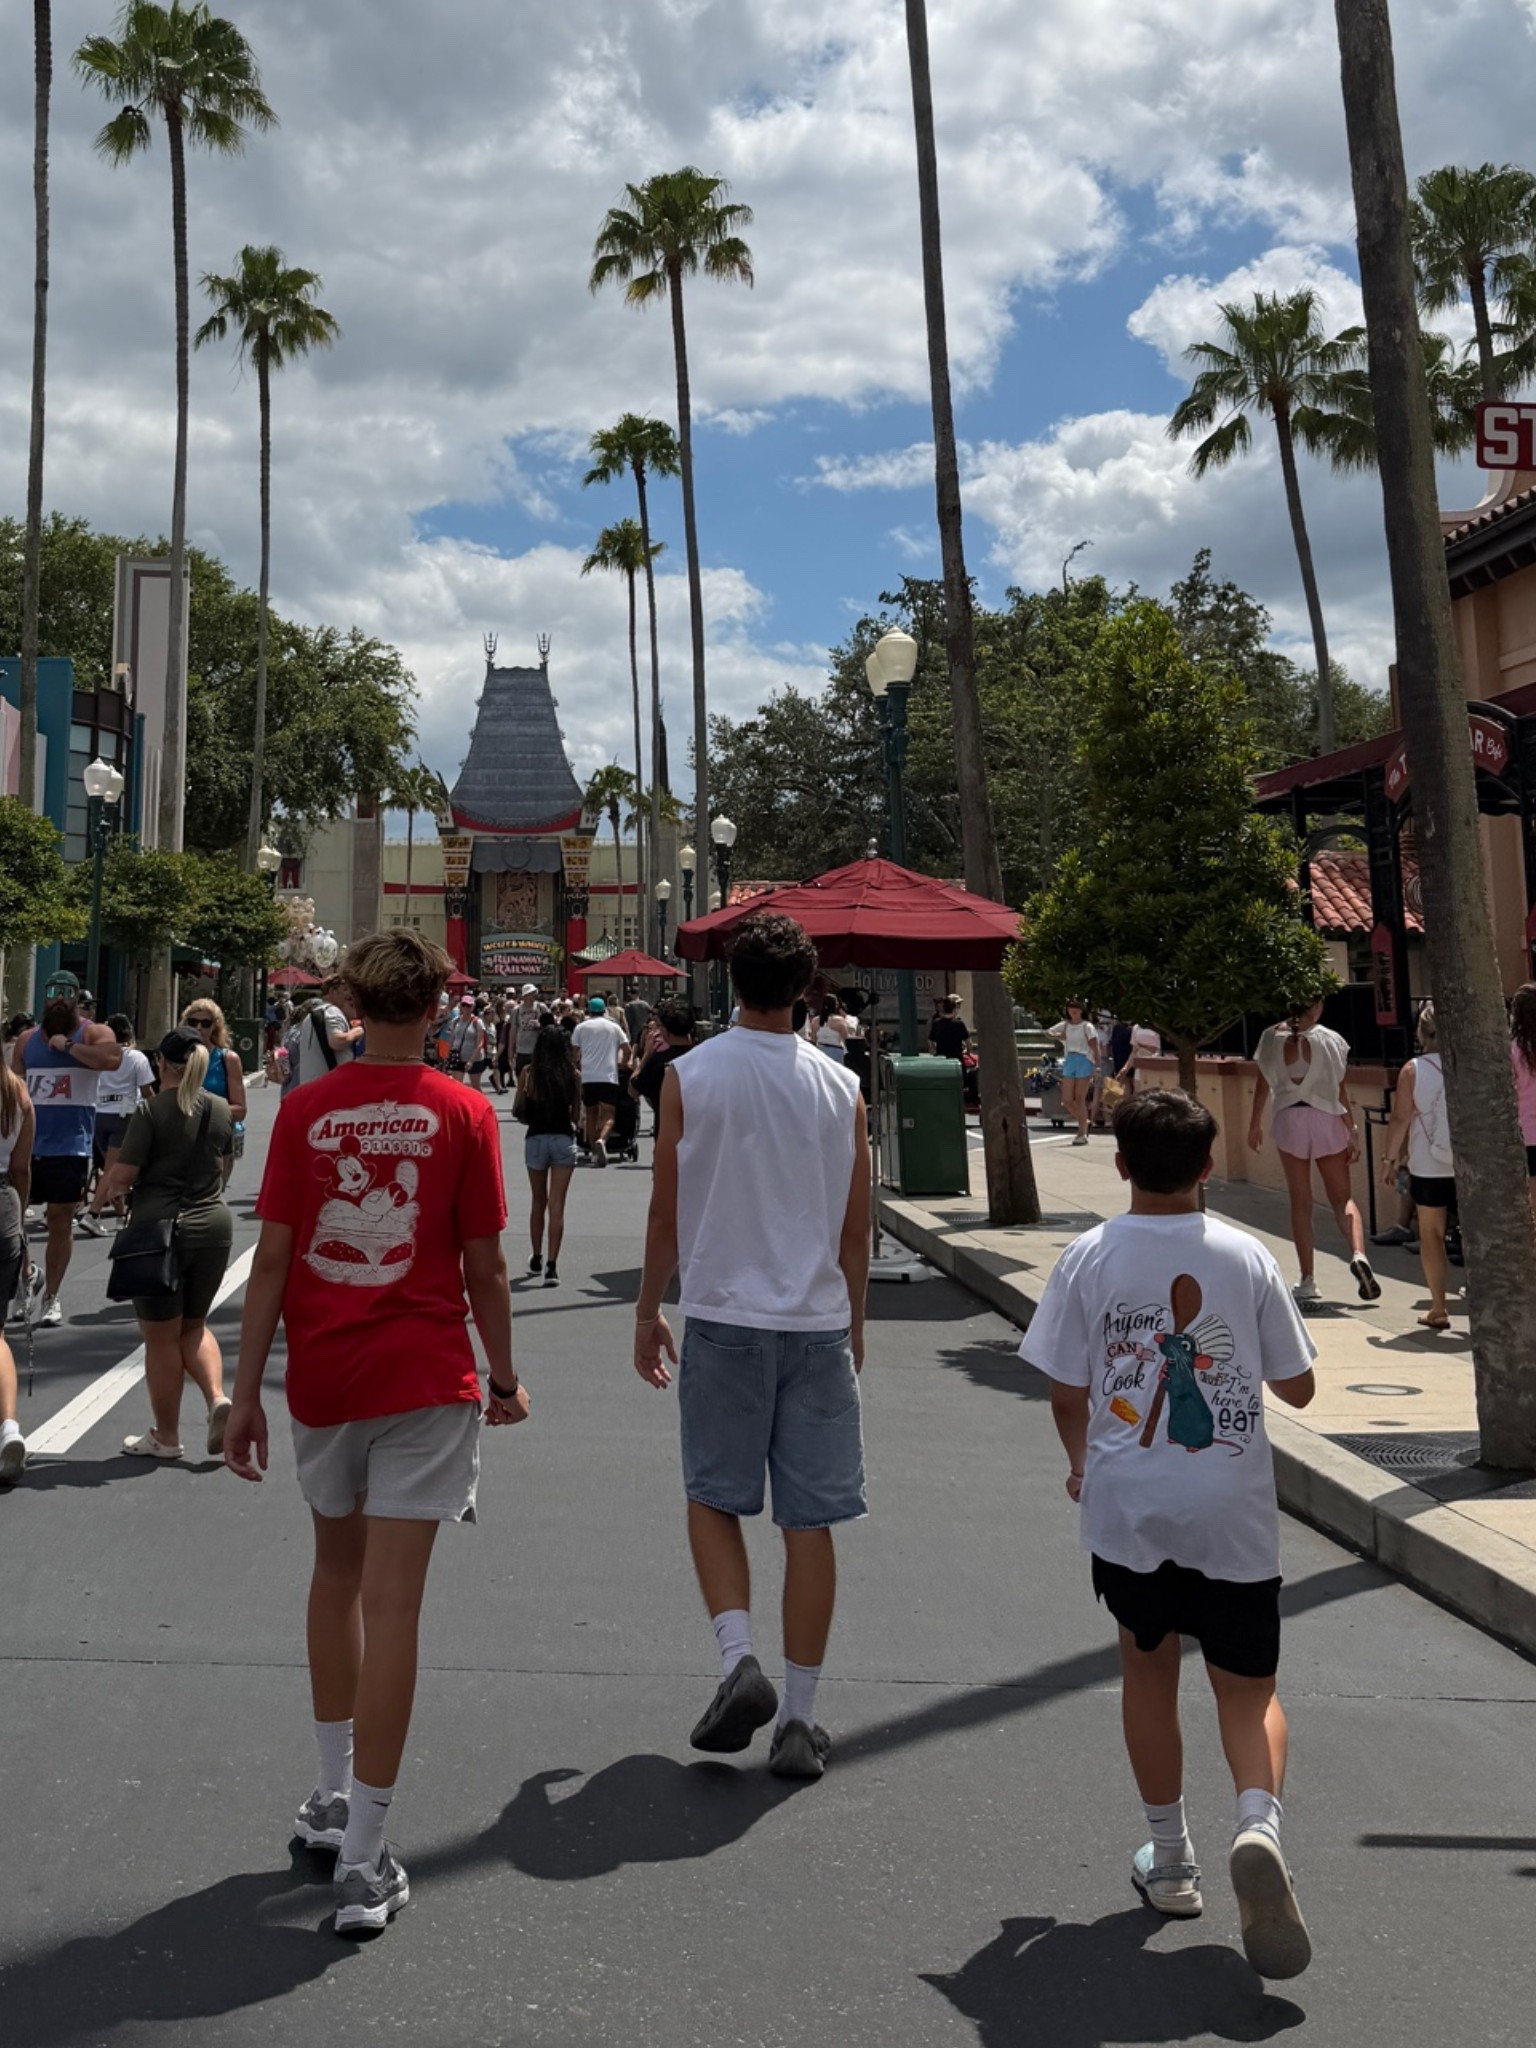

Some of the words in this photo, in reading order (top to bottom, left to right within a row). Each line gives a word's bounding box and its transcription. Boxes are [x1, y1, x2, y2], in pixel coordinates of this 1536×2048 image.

[493, 954, 542, 965] RUNAWAY
[494, 964, 541, 977] RAILWAY
[317, 1117, 429, 1141] American
[361, 1141, 430, 1155] CLASSIC
[1106, 1341, 1138, 1358] CAN
[1102, 1361, 1146, 1396] Cook
[1210, 1389, 1243, 1408] here
